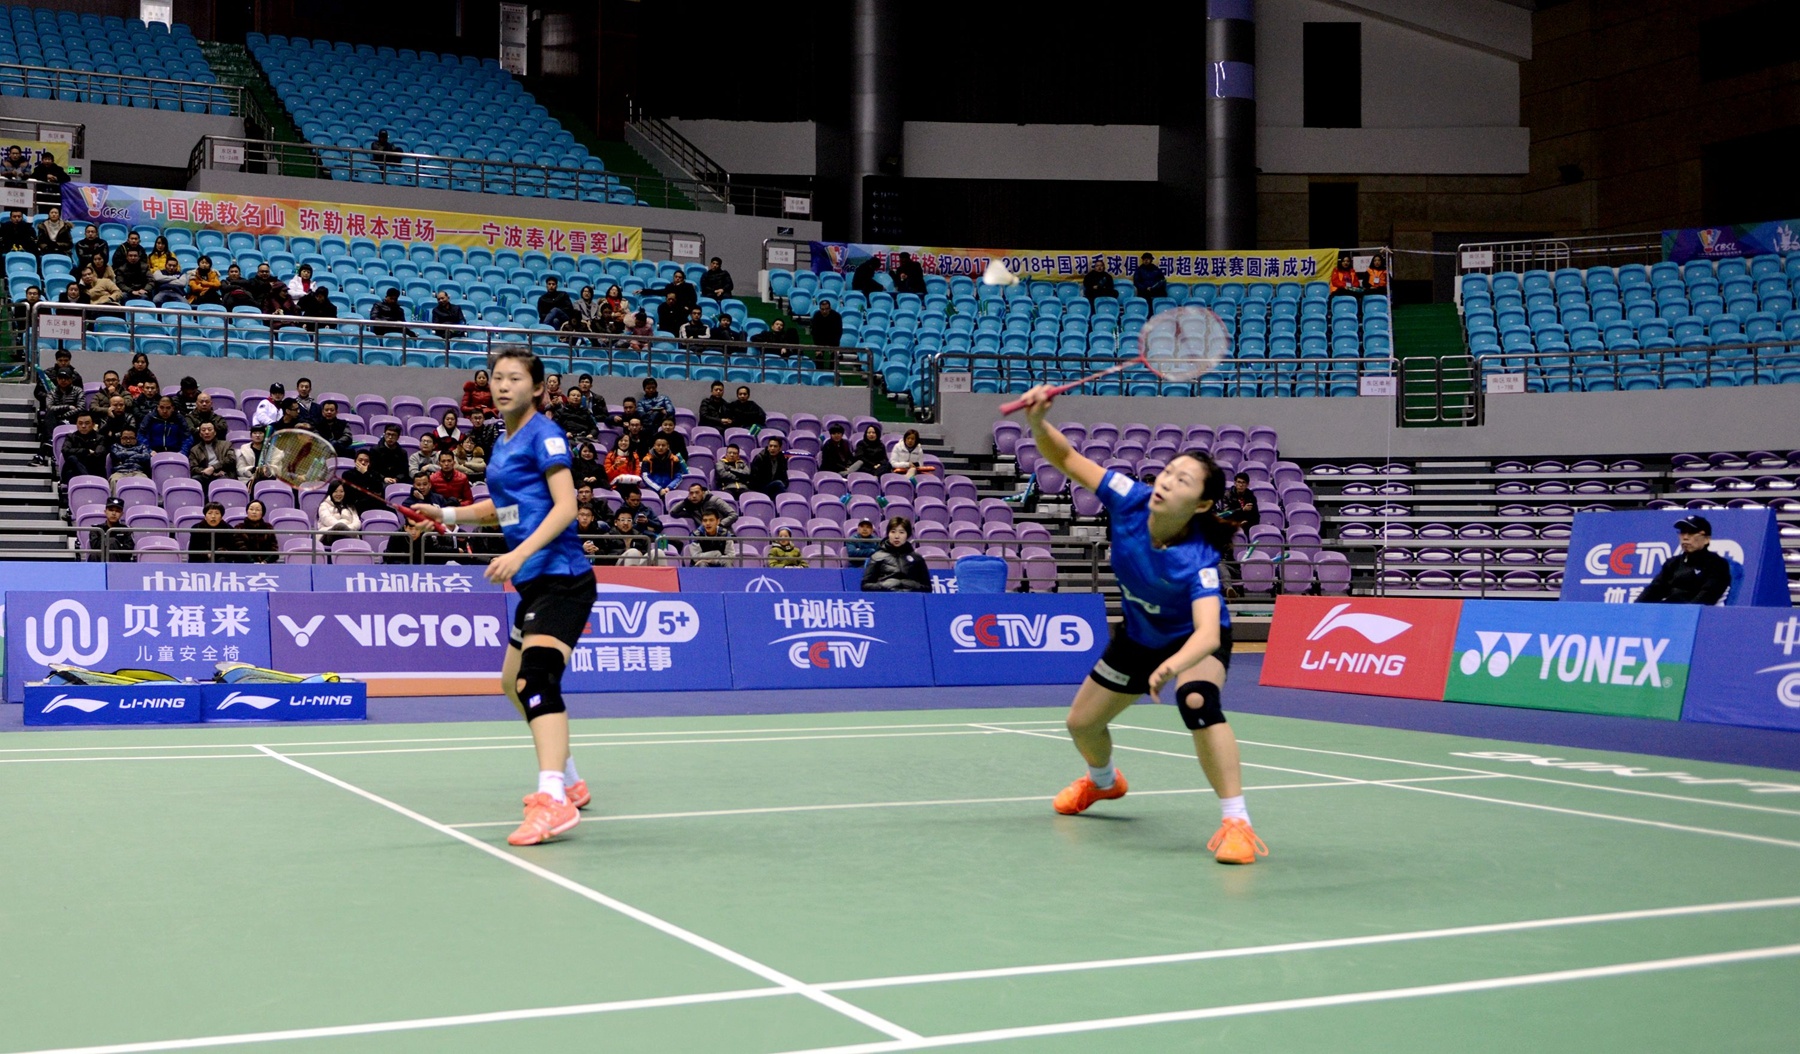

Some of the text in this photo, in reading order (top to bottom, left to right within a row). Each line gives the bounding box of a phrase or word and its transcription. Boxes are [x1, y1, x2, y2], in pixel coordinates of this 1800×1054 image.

[142, 196, 286, 228] 中国佛教名山
[122, 603, 251, 638] 贝福来
[774, 598, 876, 629] 中视体育
[334, 613, 502, 648] VICTOR
[950, 614, 1081, 648] CCTV 5
[135, 645, 241, 662] 儿童安全椅
[571, 645, 673, 672] 体育赛事
[789, 641, 871, 669] CCTV
[1300, 650, 1407, 676] LI-NING
[1538, 633, 1671, 688] YONEX
[119, 698, 186, 709] LI-NING
[289, 695, 353, 706] LI-NING
